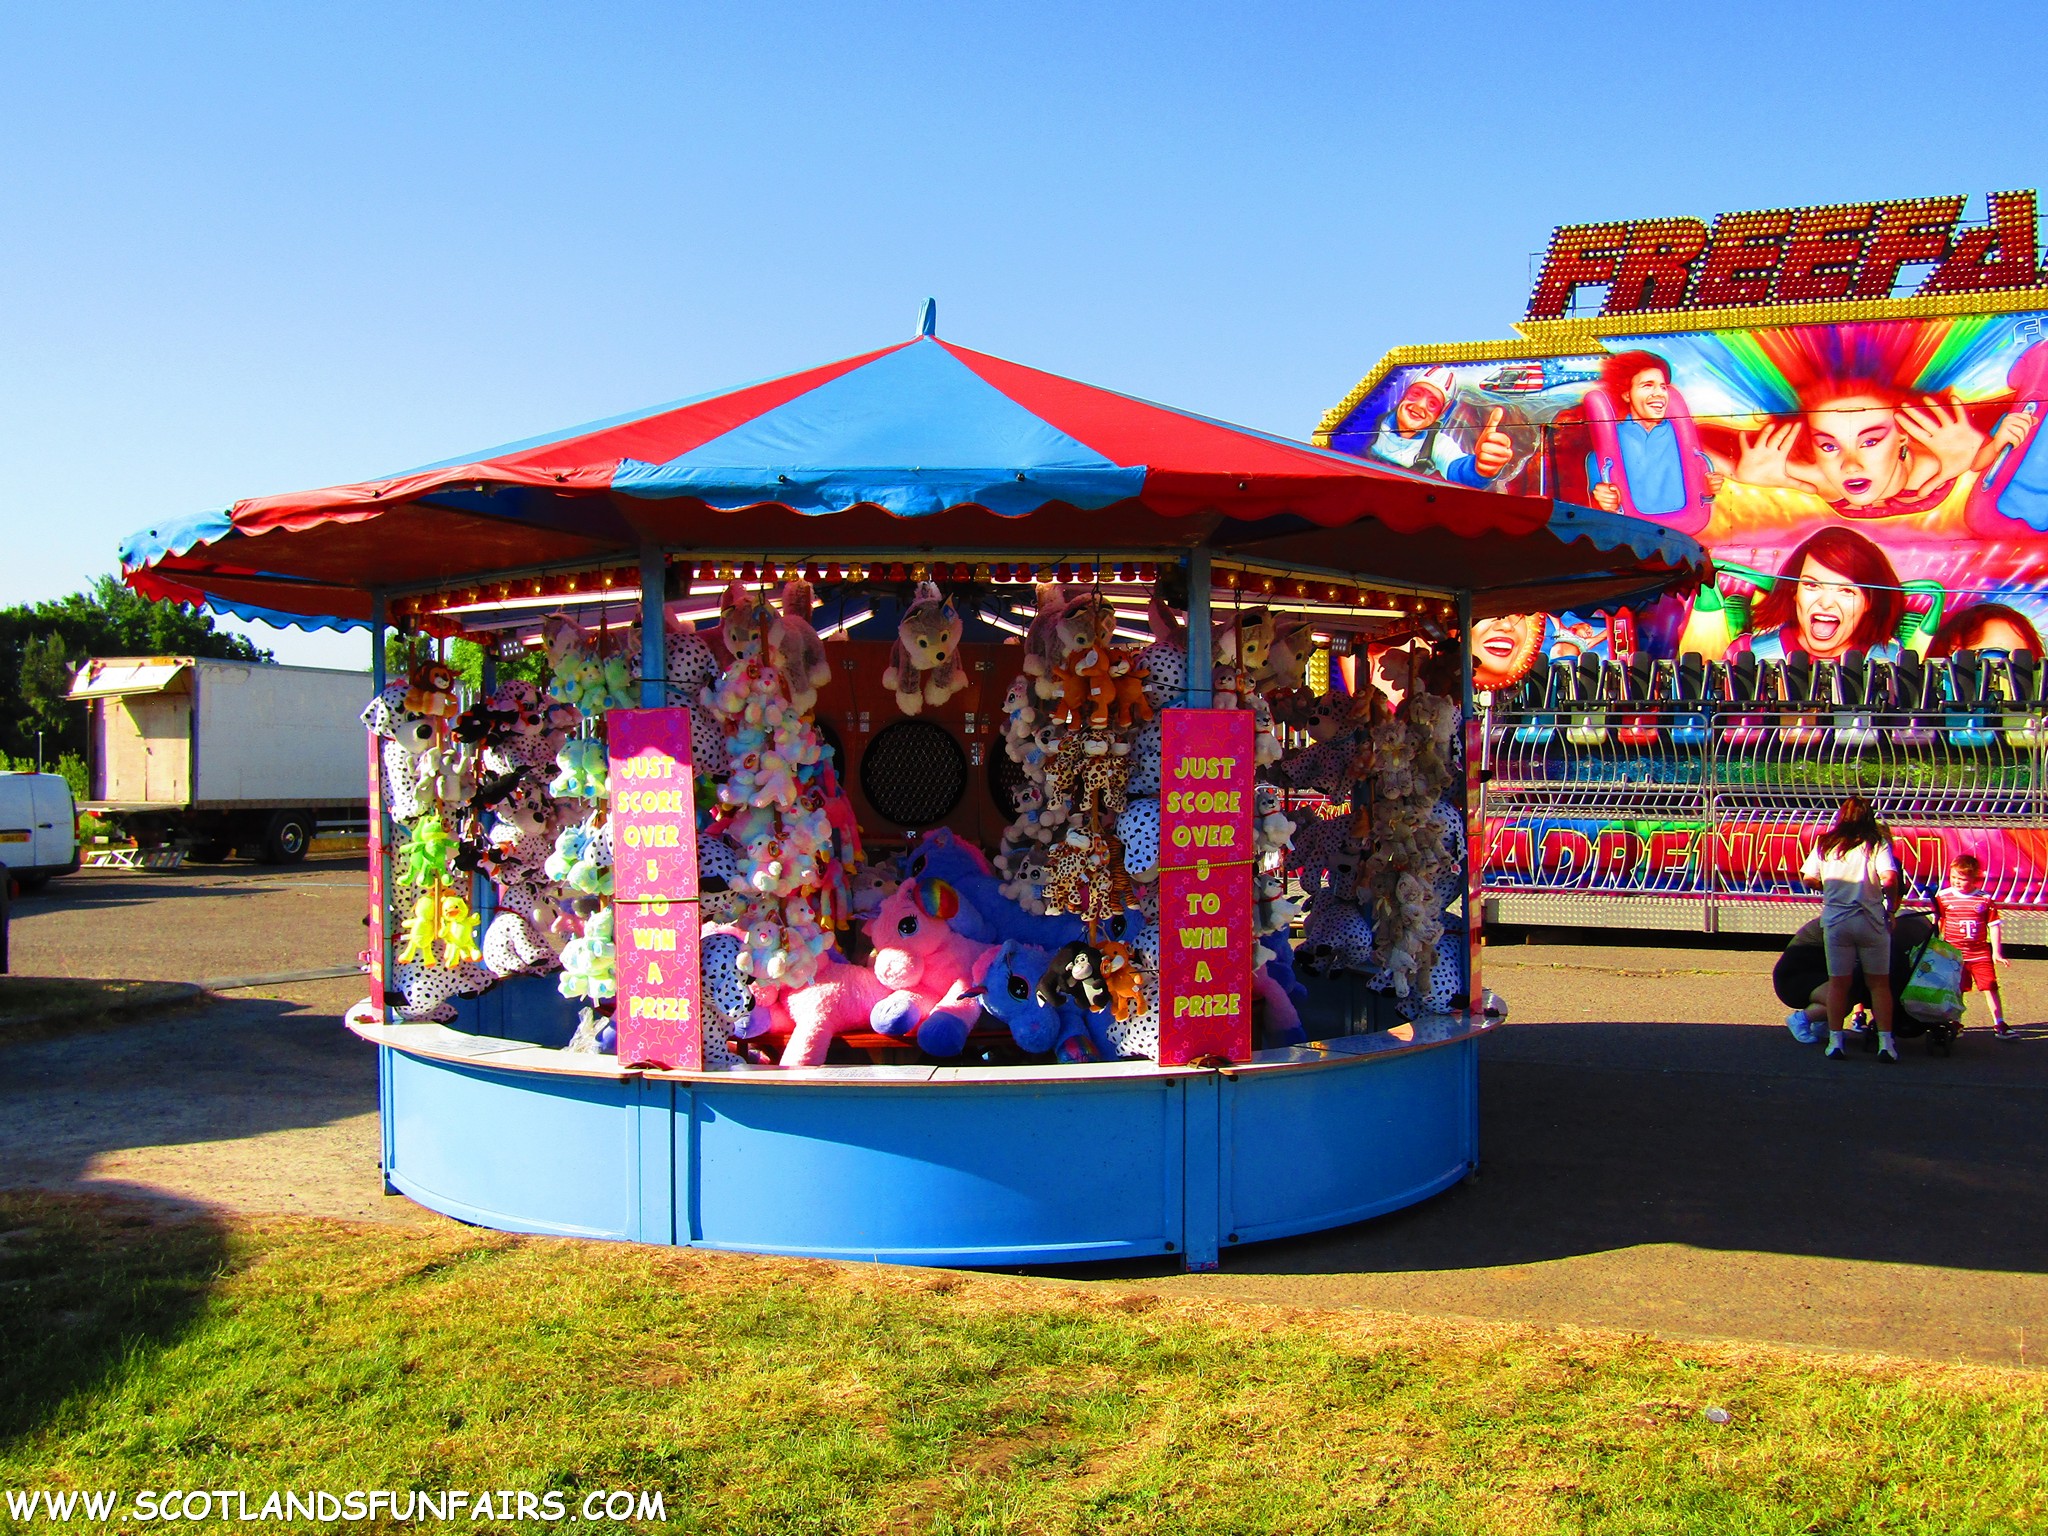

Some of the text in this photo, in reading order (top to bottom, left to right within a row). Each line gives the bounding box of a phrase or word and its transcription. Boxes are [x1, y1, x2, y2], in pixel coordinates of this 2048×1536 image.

[1523, 188, 2048, 322] FREEFA
[621, 755, 675, 779] JUST
[1174, 757, 1236, 779] JUST
[617, 790, 682, 813] SCORE
[1166, 791, 1241, 813] SCORE
[623, 825, 679, 847] OVER
[1172, 825, 1235, 847] OVER
[646, 859, 658, 882] 5
[638, 893, 669, 917] TO
[1186, 892, 1220, 915] TO
[646, 961, 664, 985] A
[1194, 960, 1213, 983] A
